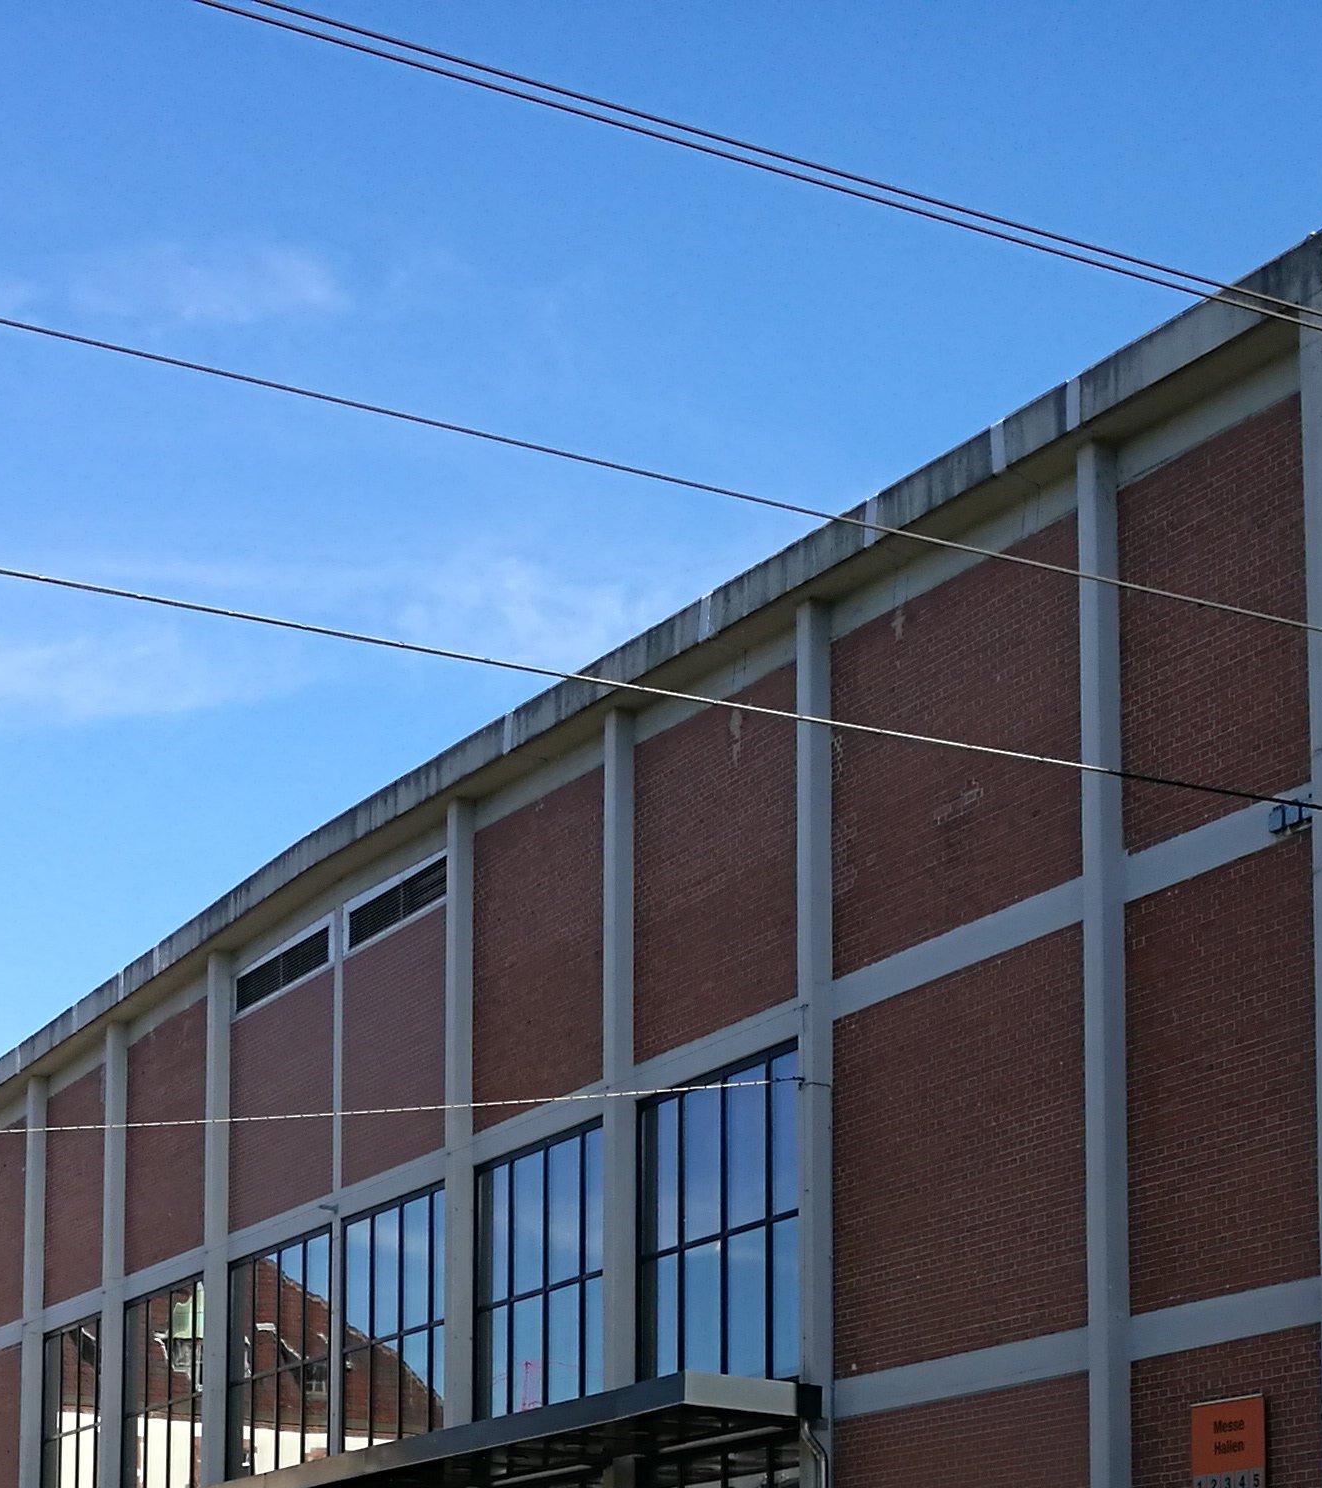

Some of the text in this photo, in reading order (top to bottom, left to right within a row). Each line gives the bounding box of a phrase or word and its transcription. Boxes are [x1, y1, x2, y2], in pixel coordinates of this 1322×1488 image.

[1213, 1419, 1246, 1434] Messe
[1213, 1440, 1246, 1455] Hallen
[1238, 1474, 1247, 1488] 4
[1253, 1473, 1261, 1488] 5
